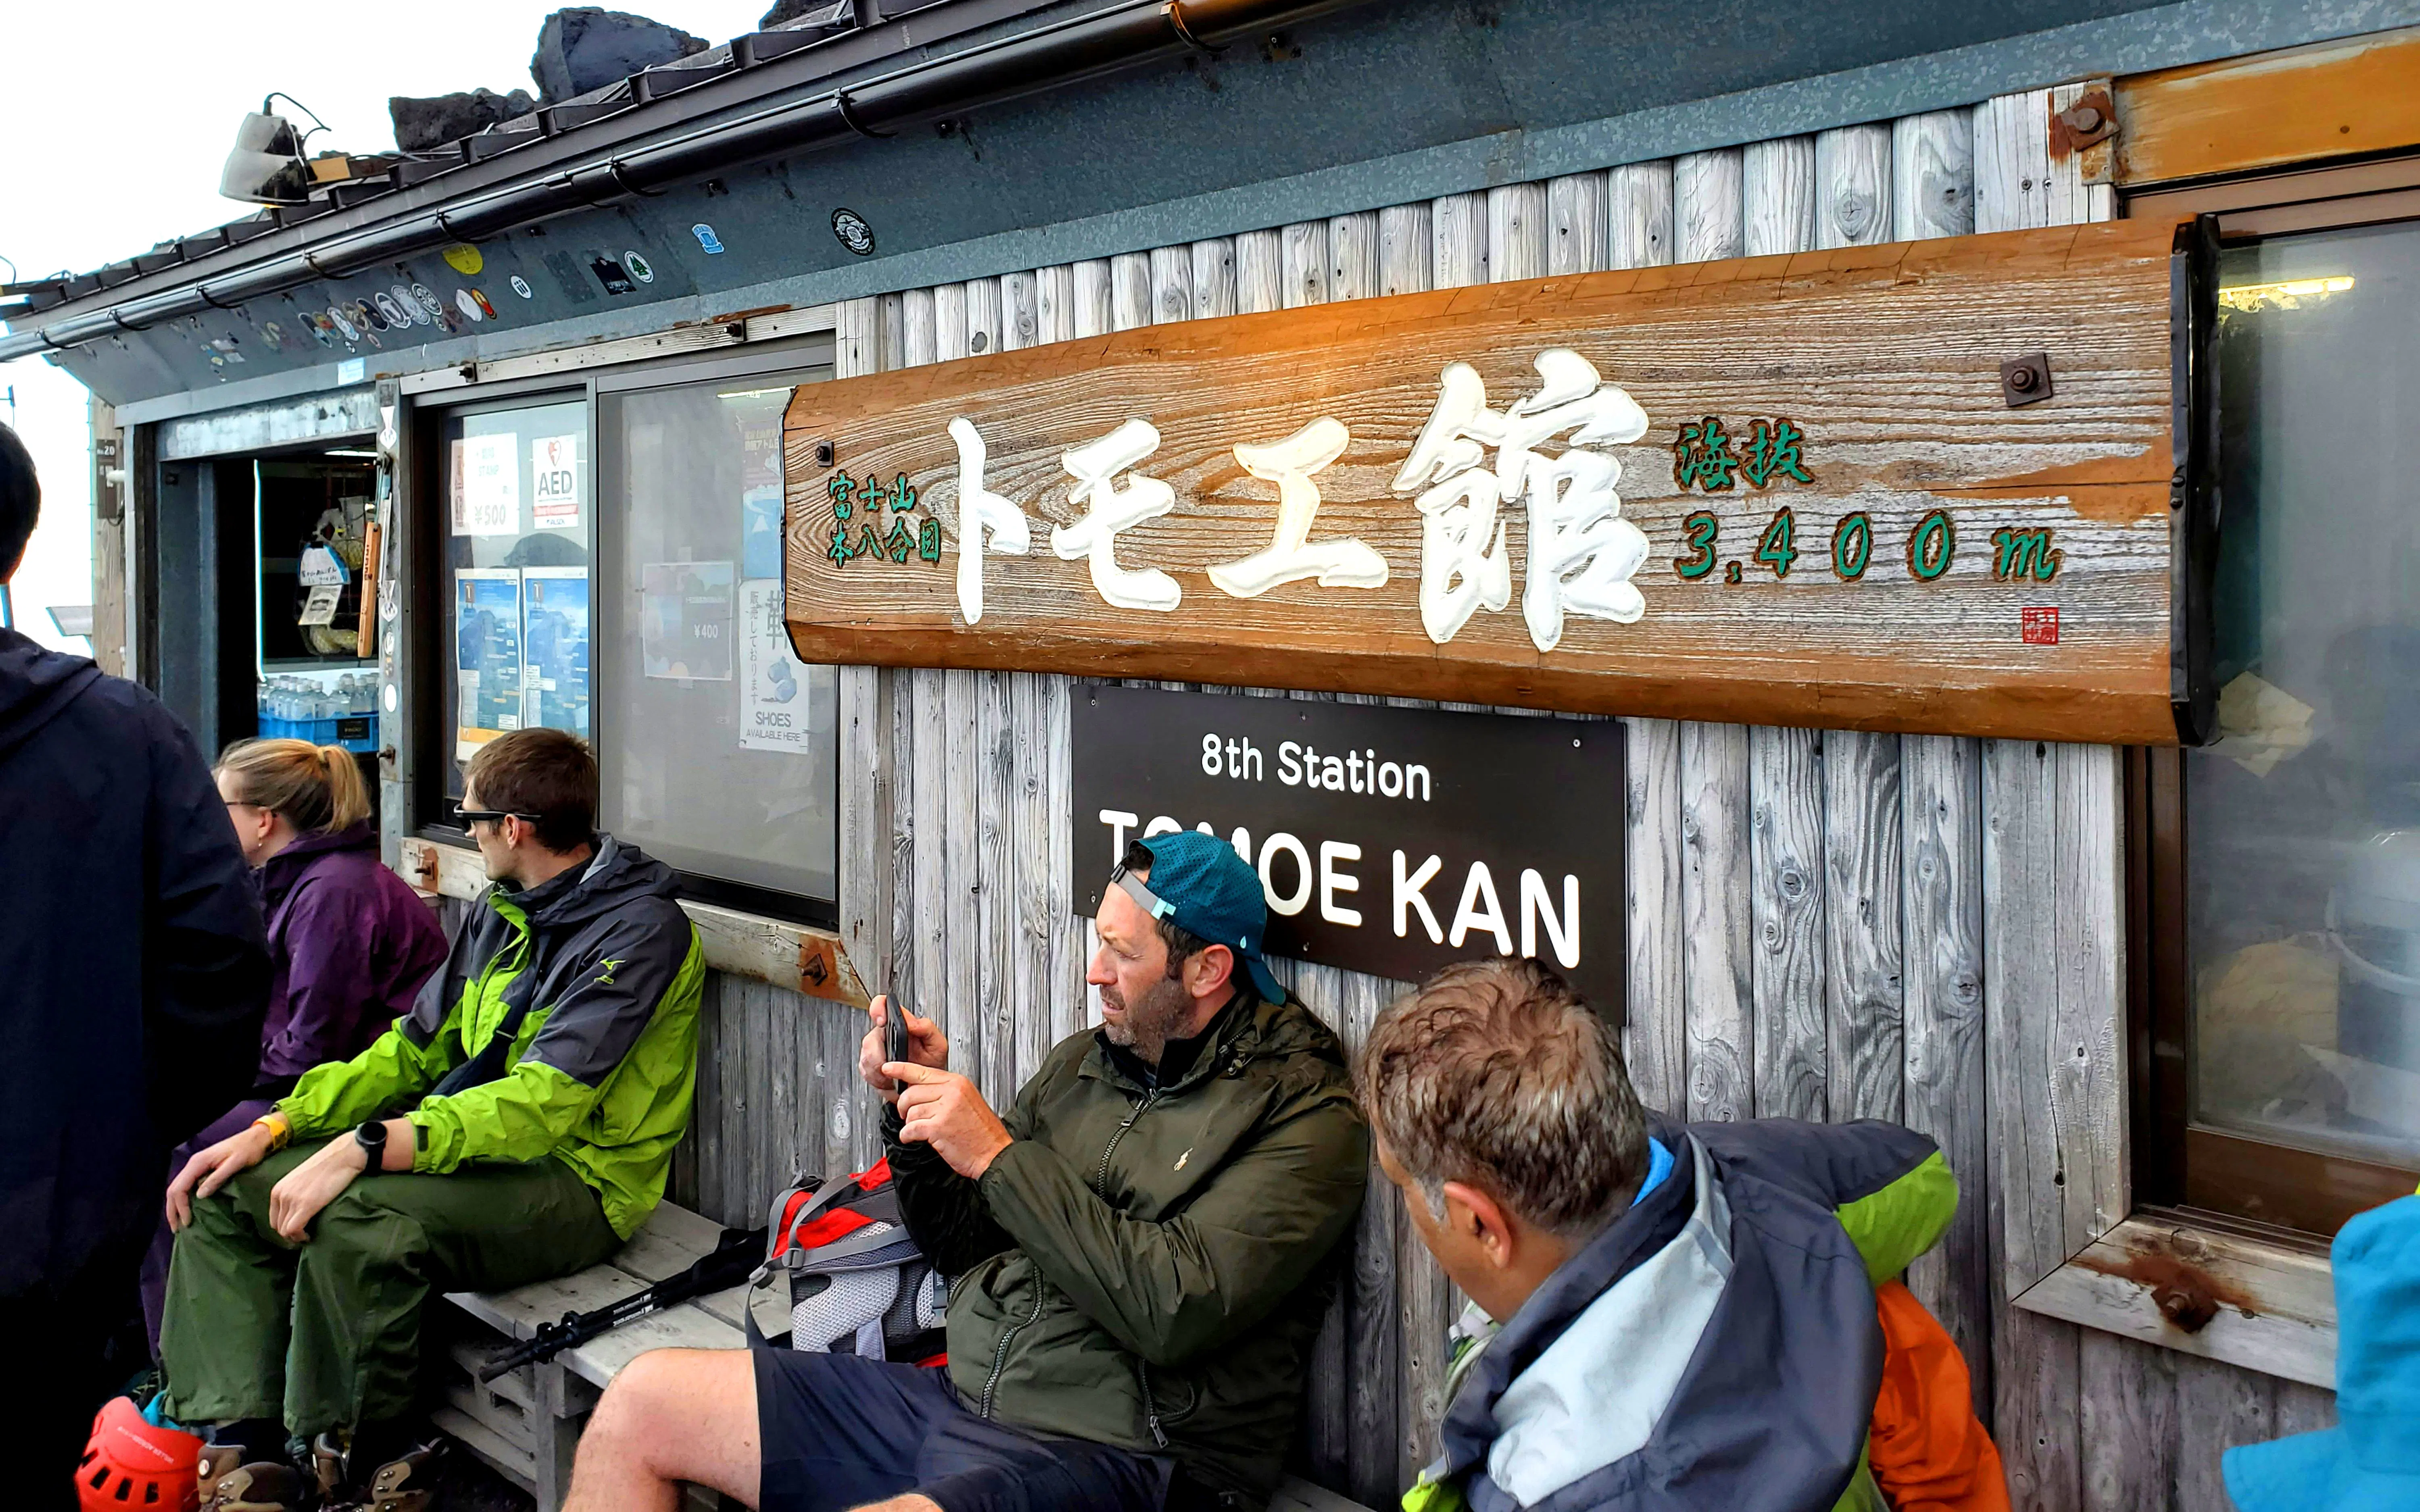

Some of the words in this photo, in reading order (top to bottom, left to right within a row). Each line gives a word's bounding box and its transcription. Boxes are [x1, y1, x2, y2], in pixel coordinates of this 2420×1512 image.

[1678, 419, 1812, 489] 海抜
[538, 470, 572, 496] AED
[828, 469, 918, 519] 富士山
[947, 348, 1649, 653] トモエ館
[474, 504, 506, 525] ¥500
[828, 518, 941, 568] 本八合目
[1676, 507, 1955, 585] 3,400
[694, 624, 718, 638] ¥400
[746, 728, 782, 740] AVAILABLE
[783, 731, 801, 741] HERE
[755, 711, 791, 728] SHOES
[1201, 733, 1263, 781] 8th
[1277, 740, 1431, 802] Station
[1099, 809, 1363, 927] TOE
[1392, 848, 1581, 969] KAN
